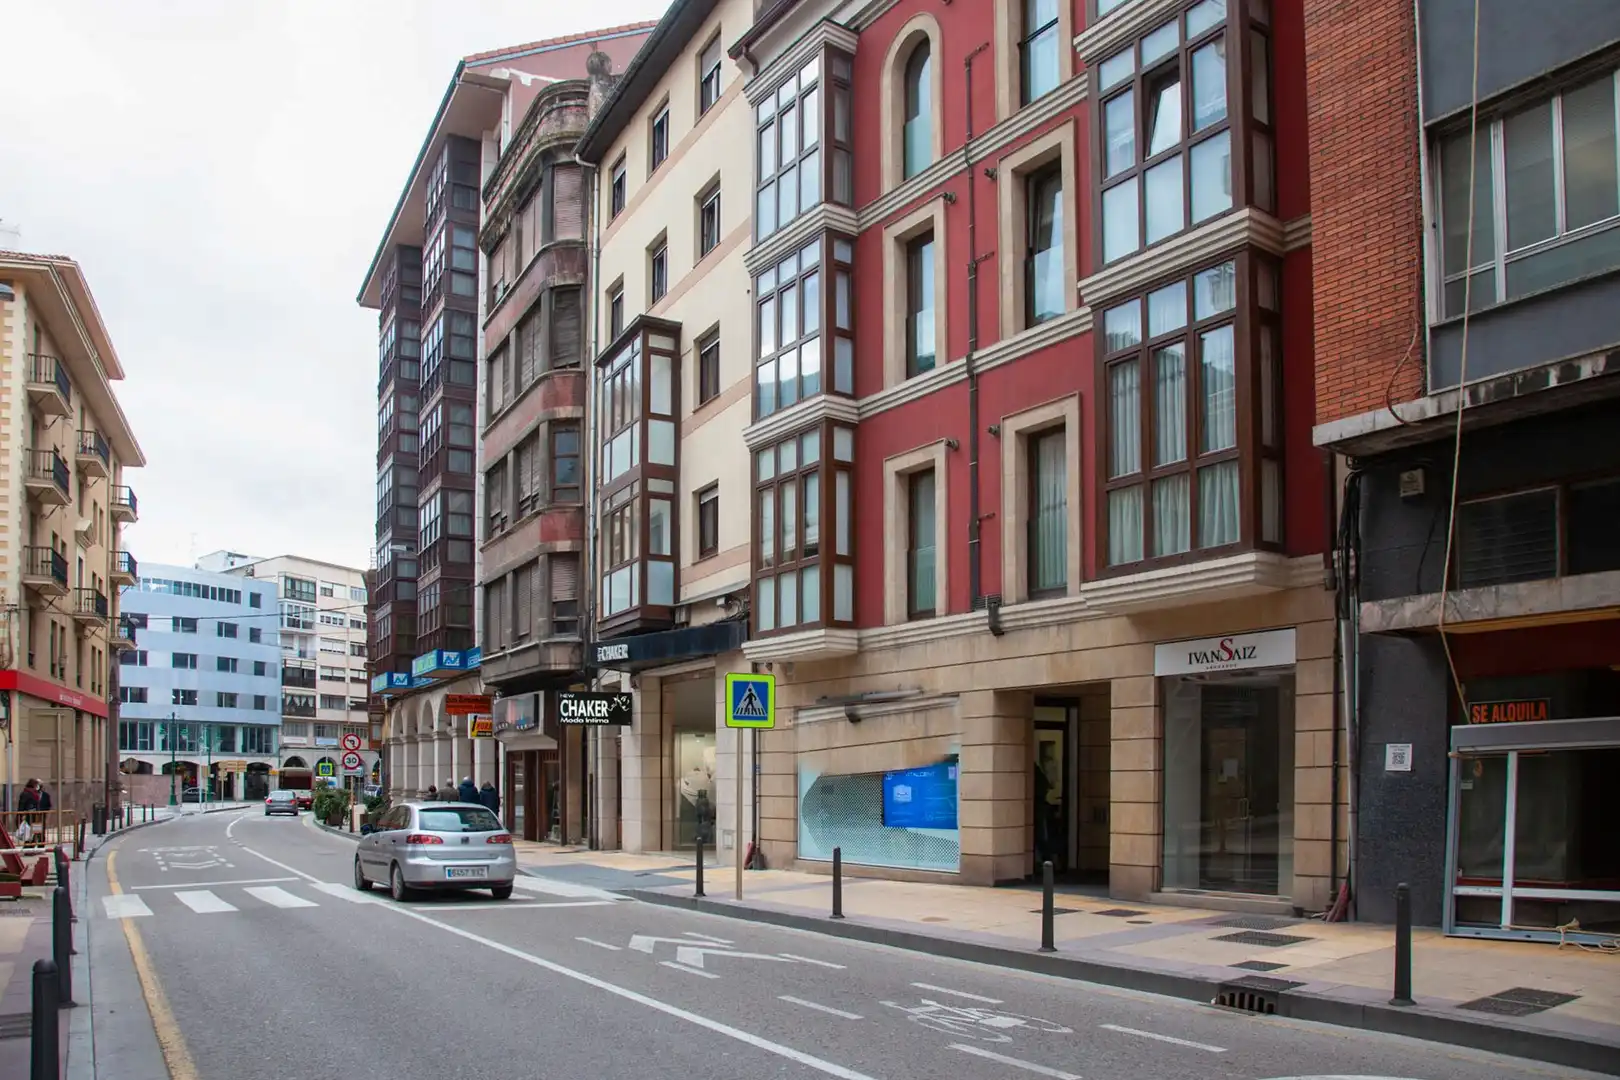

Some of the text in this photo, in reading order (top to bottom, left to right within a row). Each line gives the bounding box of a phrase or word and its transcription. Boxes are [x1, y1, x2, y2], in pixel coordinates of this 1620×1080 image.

[602, 643, 629, 660] CHAKER
[560, 699, 609, 717] CHAKER
[1472, 701, 1547, 723] SE ALQUILA
